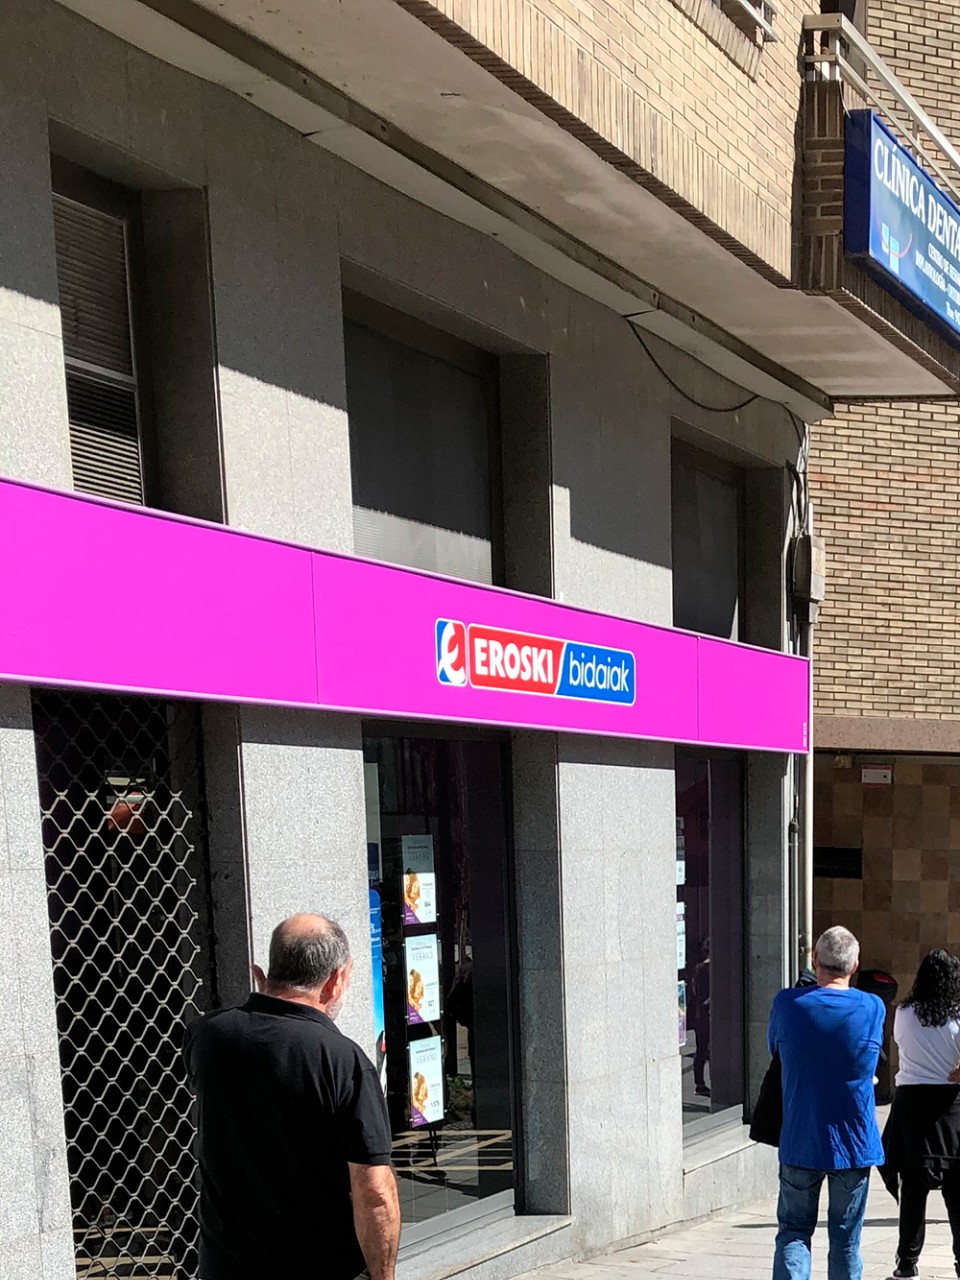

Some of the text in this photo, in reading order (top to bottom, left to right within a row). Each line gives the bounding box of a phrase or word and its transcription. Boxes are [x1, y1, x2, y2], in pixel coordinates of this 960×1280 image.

[874, 138, 926, 224] CLÍNICA
[474, 638, 630, 692] EROSKI bidaiak
